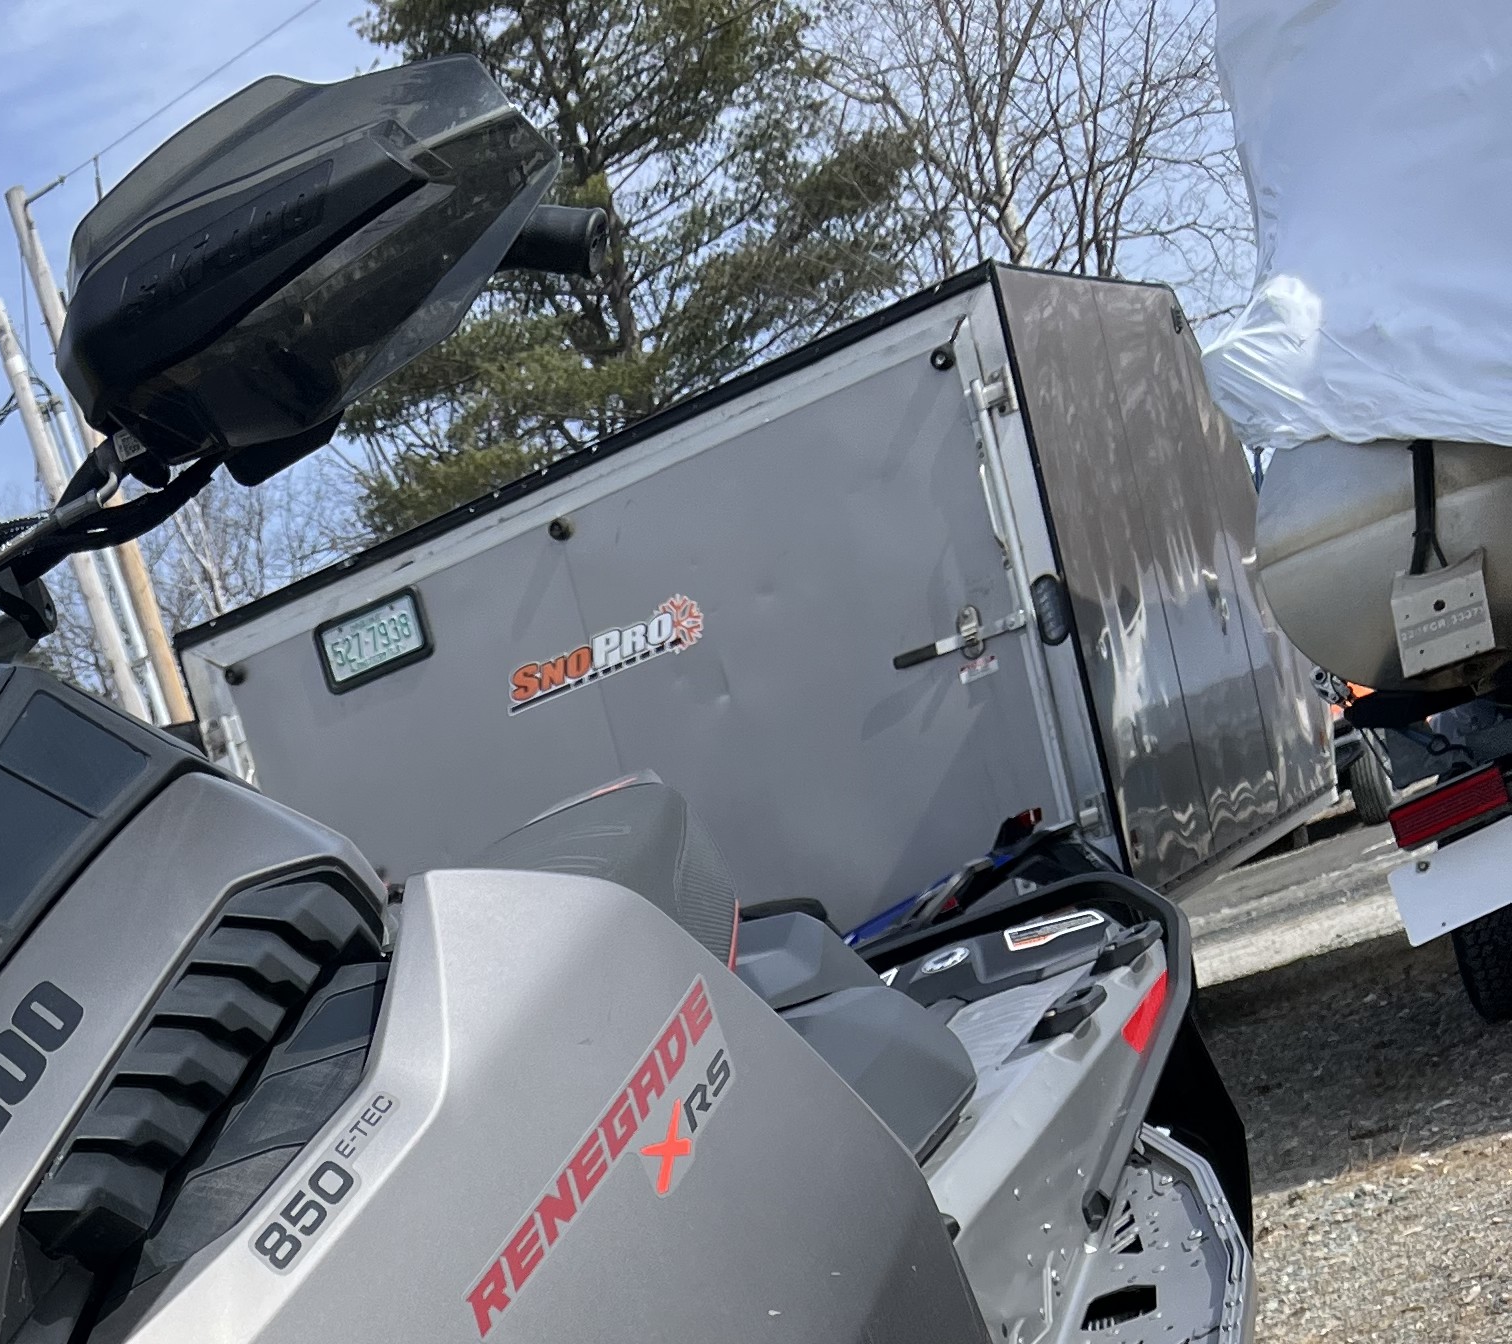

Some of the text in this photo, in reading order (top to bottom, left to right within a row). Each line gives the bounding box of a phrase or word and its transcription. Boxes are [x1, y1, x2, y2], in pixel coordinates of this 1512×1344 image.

[254, 1094, 393, 1270] 850 E-TEC
[465, 980, 713, 1340] RENEGADE
